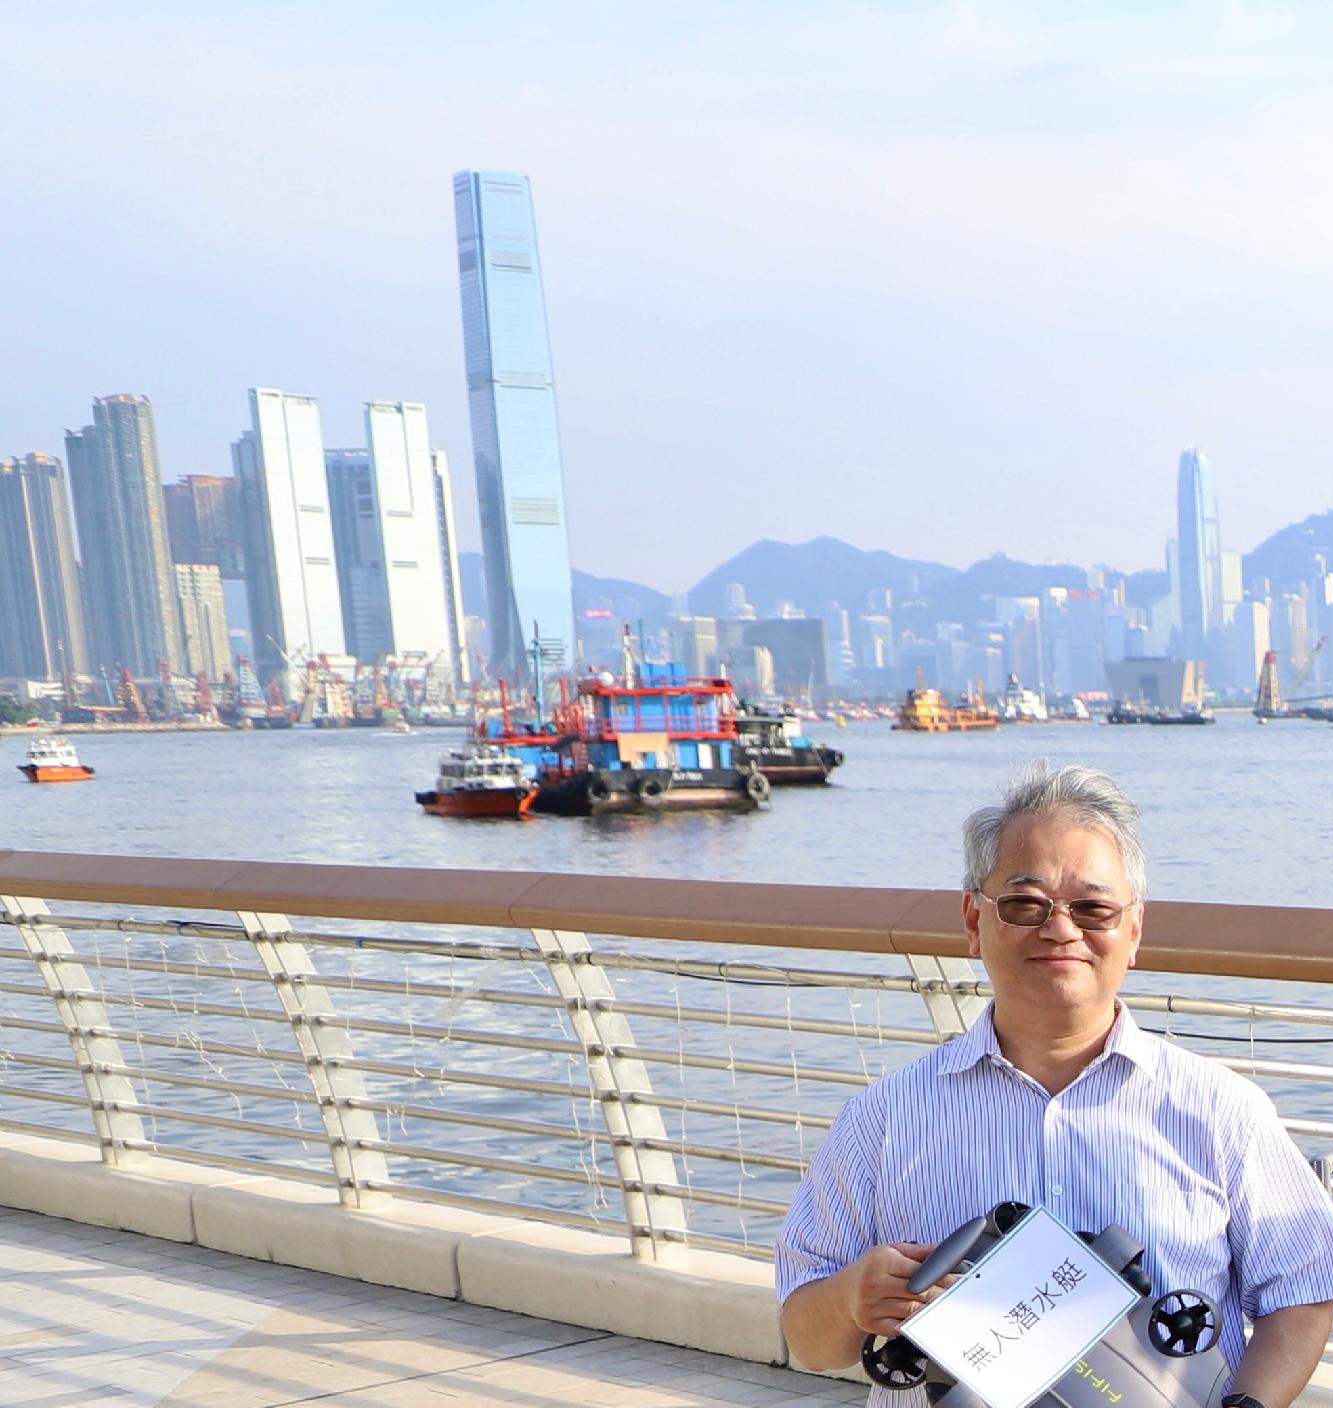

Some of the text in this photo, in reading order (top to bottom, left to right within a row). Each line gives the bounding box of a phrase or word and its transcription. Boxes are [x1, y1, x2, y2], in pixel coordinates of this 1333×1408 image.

[963, 1256, 1089, 1373] 無人潛水艇
